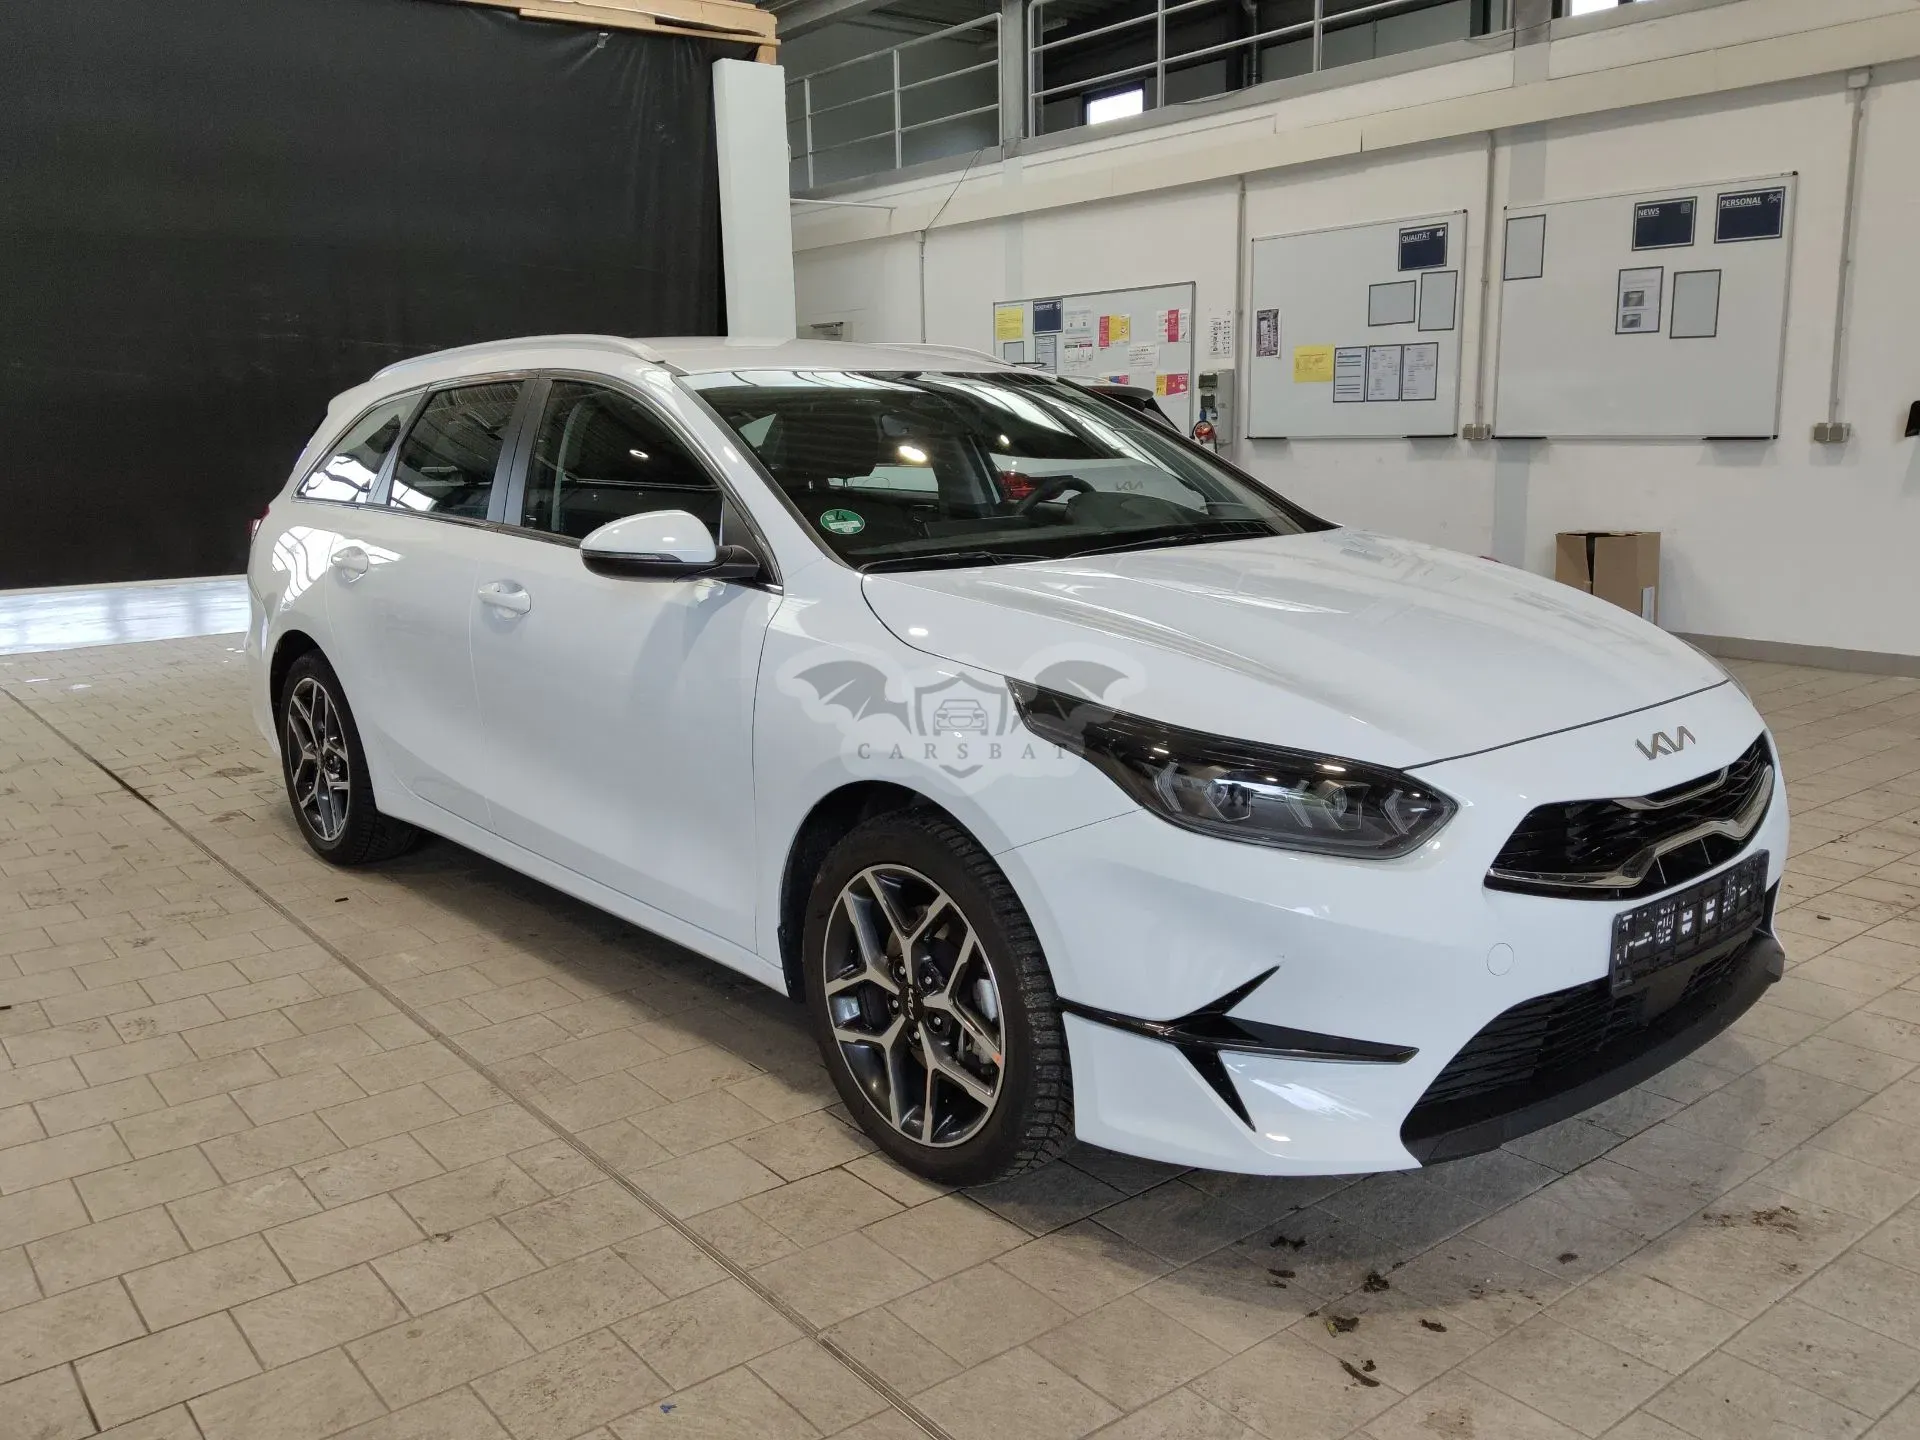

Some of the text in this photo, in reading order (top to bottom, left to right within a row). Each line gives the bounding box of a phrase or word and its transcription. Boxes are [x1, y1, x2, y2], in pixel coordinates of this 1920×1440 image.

[1720, 197, 1762, 209] PERSONAL
[1637, 207, 1660, 218] NEWS
[1401, 231, 1431, 244] QUALITÄT
[834, 510, 848, 521] 4
[1635, 725, 1696, 761] KIA
